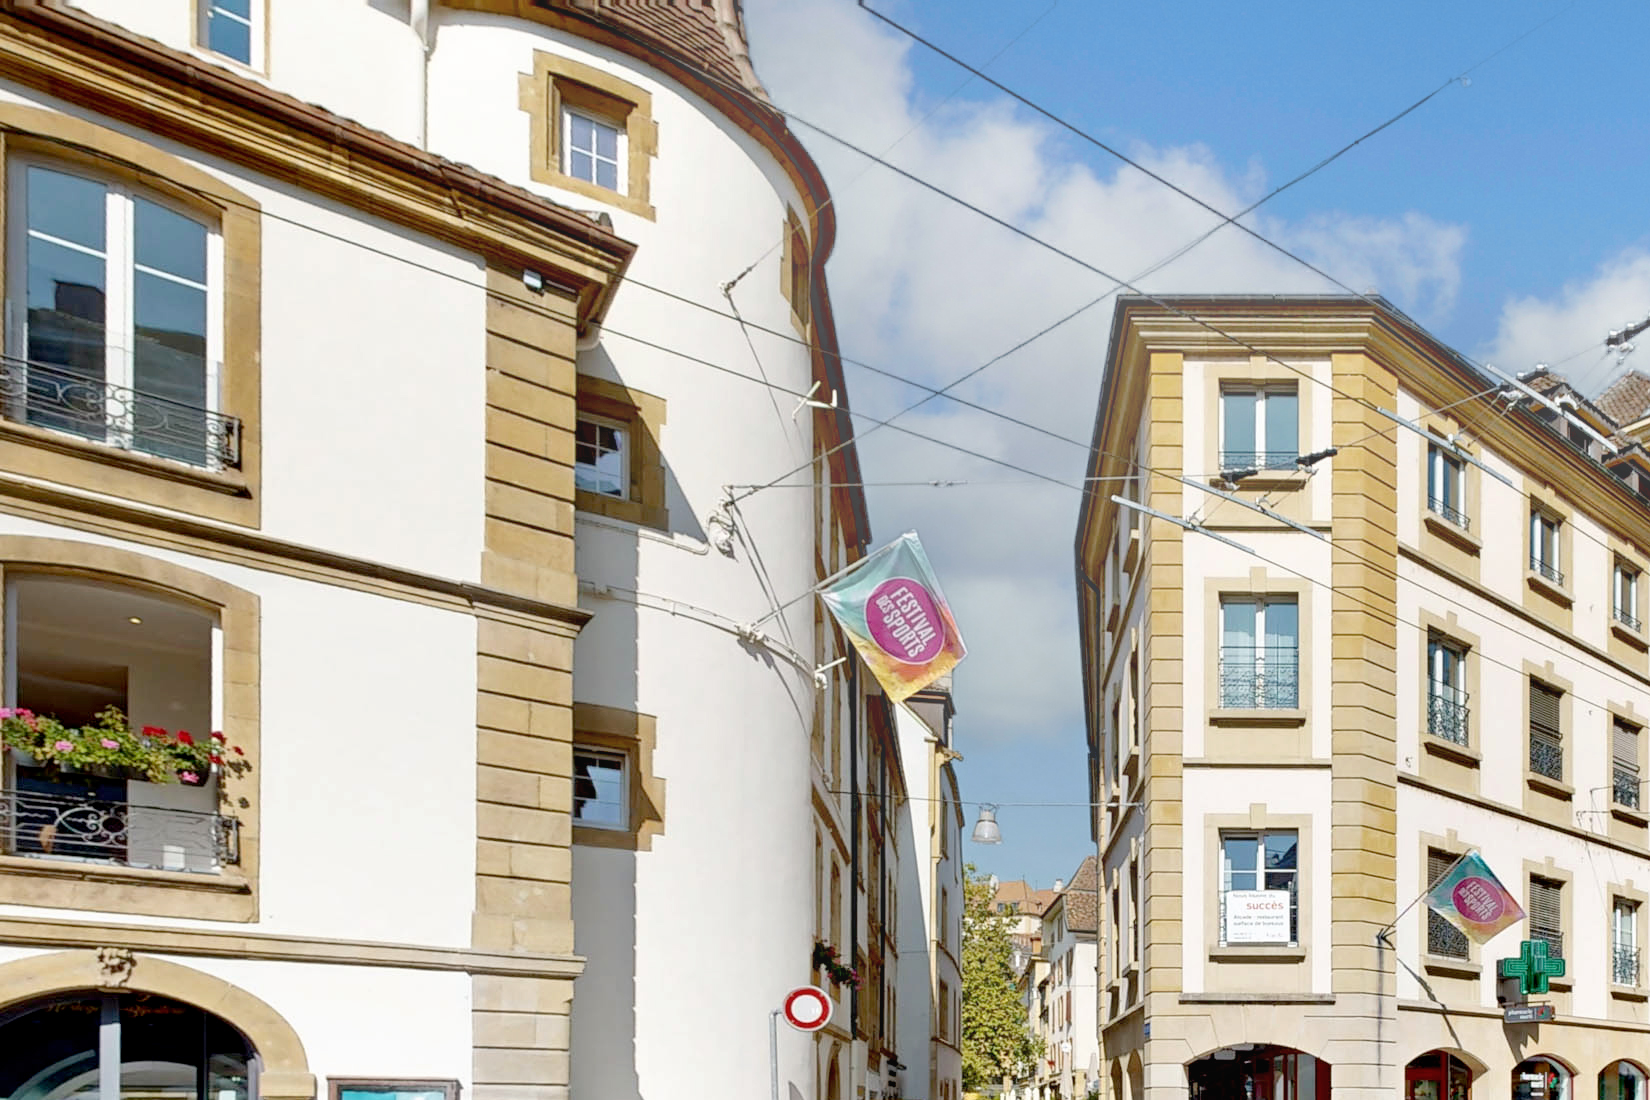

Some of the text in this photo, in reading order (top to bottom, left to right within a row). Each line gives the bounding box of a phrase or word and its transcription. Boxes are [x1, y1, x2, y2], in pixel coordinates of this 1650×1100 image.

[876, 594, 926, 658] DES SPORTS
[890, 586, 936, 646] FESTIVAL
[1246, 900, 1284, 910] succès
[1463, 893, 1492, 920] SPORTS
[1466, 881, 1498, 914] FESTIVAL
